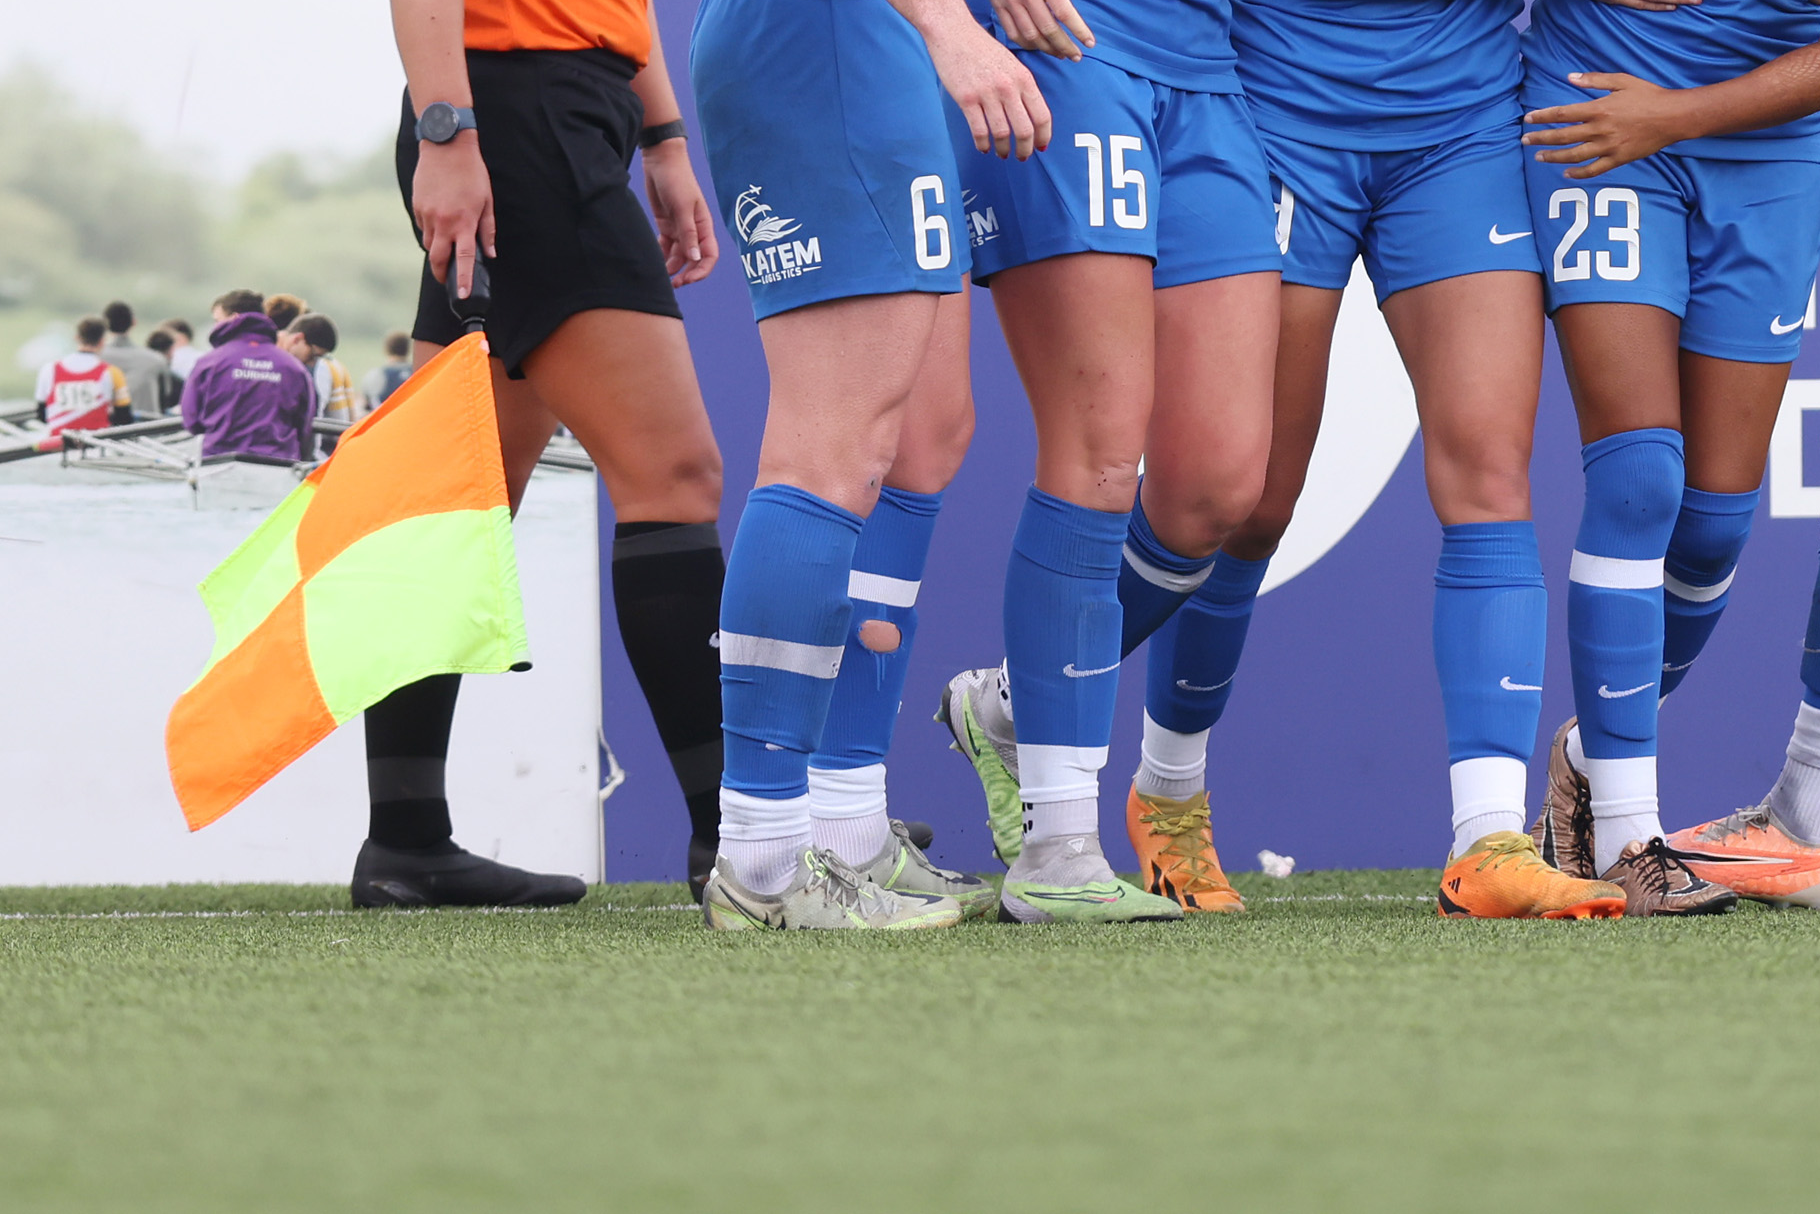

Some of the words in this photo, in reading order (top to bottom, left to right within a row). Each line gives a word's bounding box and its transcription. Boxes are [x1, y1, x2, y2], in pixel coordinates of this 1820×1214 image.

[1074, 132, 1149, 230] 15
[910, 174, 952, 271] 6
[1548, 187, 1642, 283] 23
[741, 236, 823, 279] KATEM
[760, 266, 803, 285] LOGISTICS
[232, 368, 282, 382] DURHAM
[242, 358, 273, 370] TEAM
